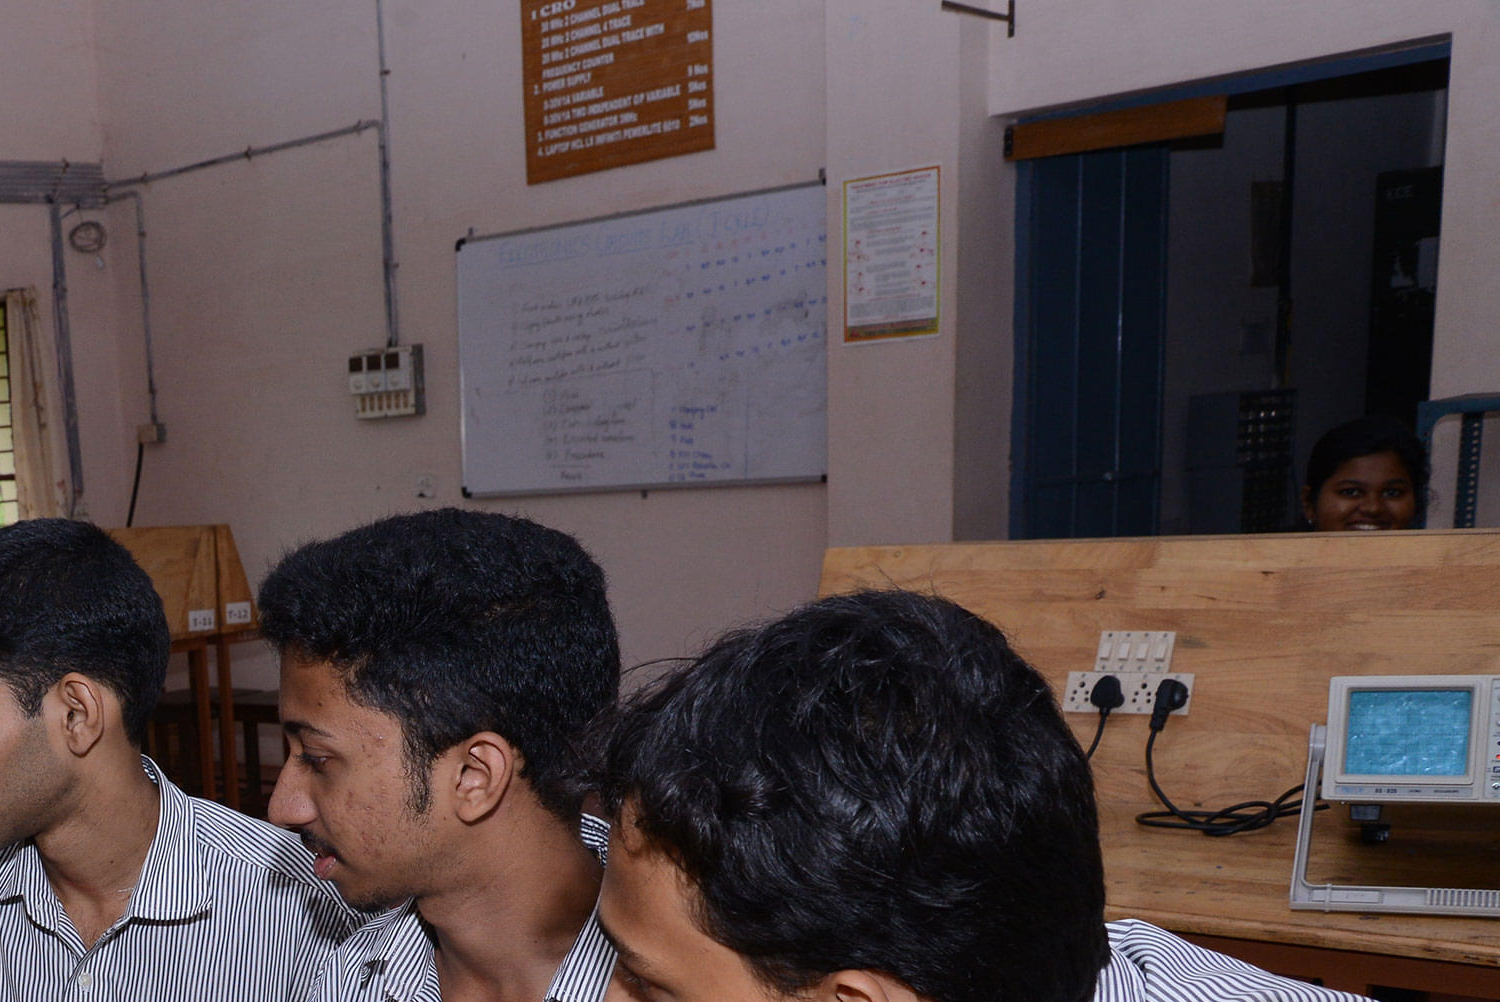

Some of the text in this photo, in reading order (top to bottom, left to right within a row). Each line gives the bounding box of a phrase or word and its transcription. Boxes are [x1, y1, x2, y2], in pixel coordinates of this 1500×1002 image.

[540, 0, 576, 17] CRO
[570, 6, 601, 25] CHANNEL
[602, 1, 620, 16] DUAL
[570, 23, 602, 41] CHANNEL
[609, 15, 631, 30] TRACE
[570, 39, 602, 57] CHANNEL
[602, 35, 620, 48] DUAL
[621, 28, 645, 43] TRACE
[542, 61, 581, 80] FREQUENCY
[582, 52, 614, 70] COUNTER
[542, 77, 565, 93] POWER
[566, 72, 592, 88] SUPPLY
[646, 84, 681, 103] VARIABLE
[571, 86, 604, 103] VARIABLE
[544, 124, 578, 140] FUNCTION
[579, 114, 618, 133] GENERATOR
[544, 141, 570, 156] LAPTOP
